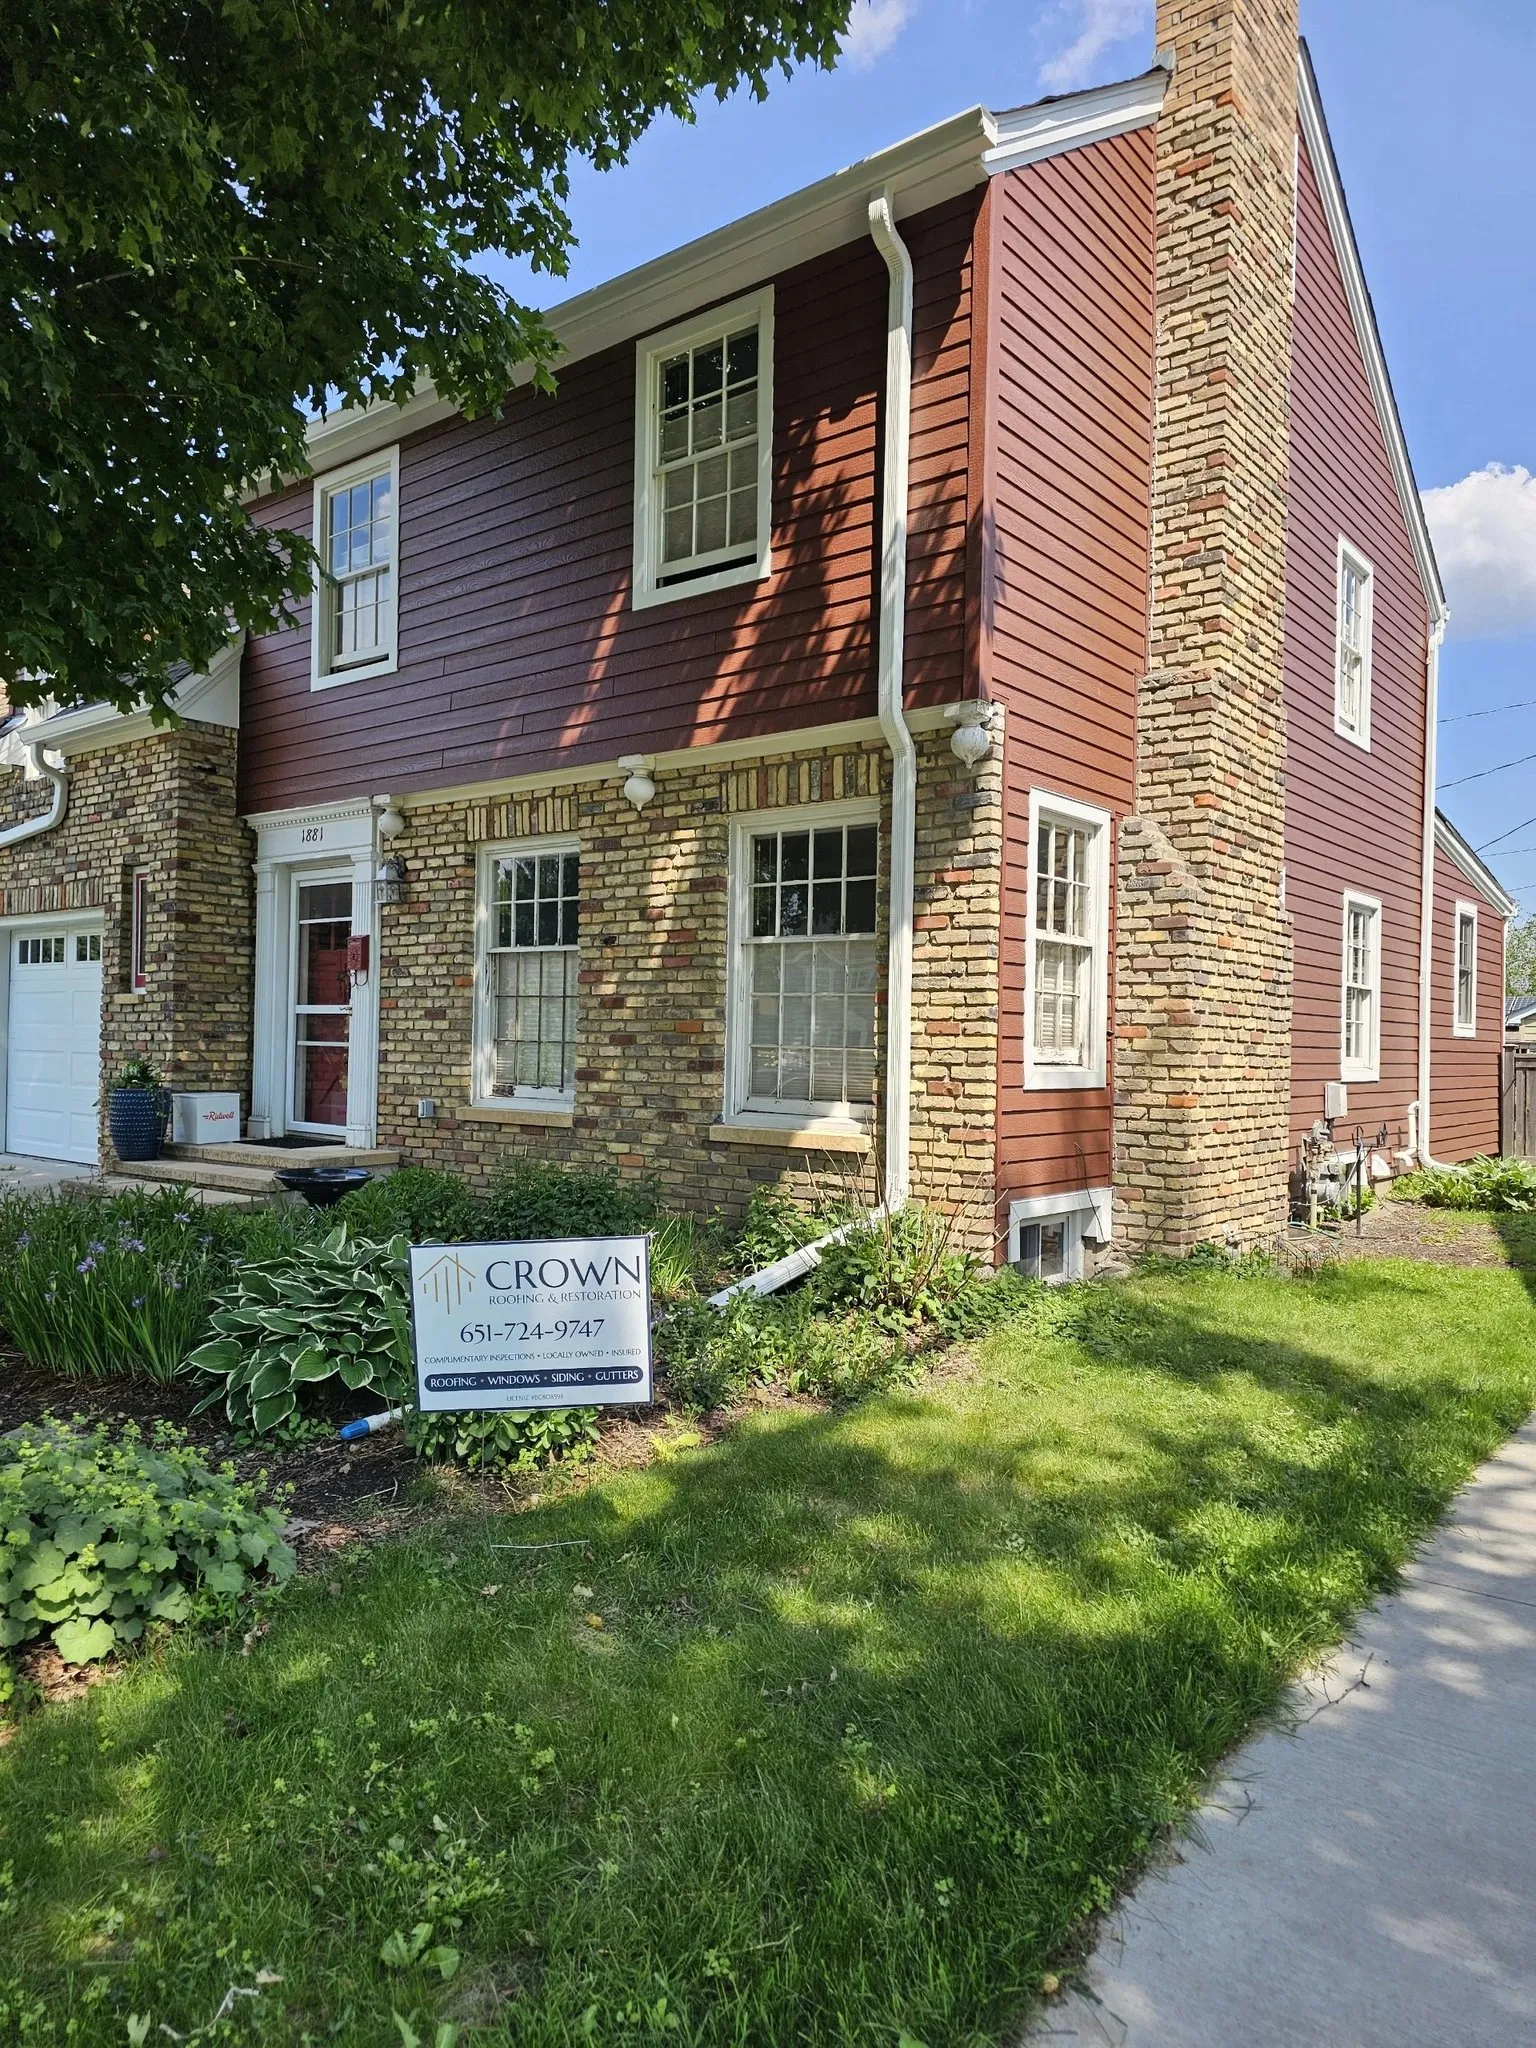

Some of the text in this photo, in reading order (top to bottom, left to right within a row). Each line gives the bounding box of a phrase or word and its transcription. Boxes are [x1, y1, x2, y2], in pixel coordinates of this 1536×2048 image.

[302, 827, 323, 843] 1881
[485, 1255, 641, 1290] CROWN
[489, 1289, 642, 1305] ROOFING & RESTORATION
[460, 1319, 605, 1345] 651-724-9747
[424, 1348, 642, 1364] COMPLIMENTARY INSPECTIONS LOCALLY OWNED INSURED
[430, 1370, 639, 1388] ROOFING WINDOWS SIDING GUTTERS
